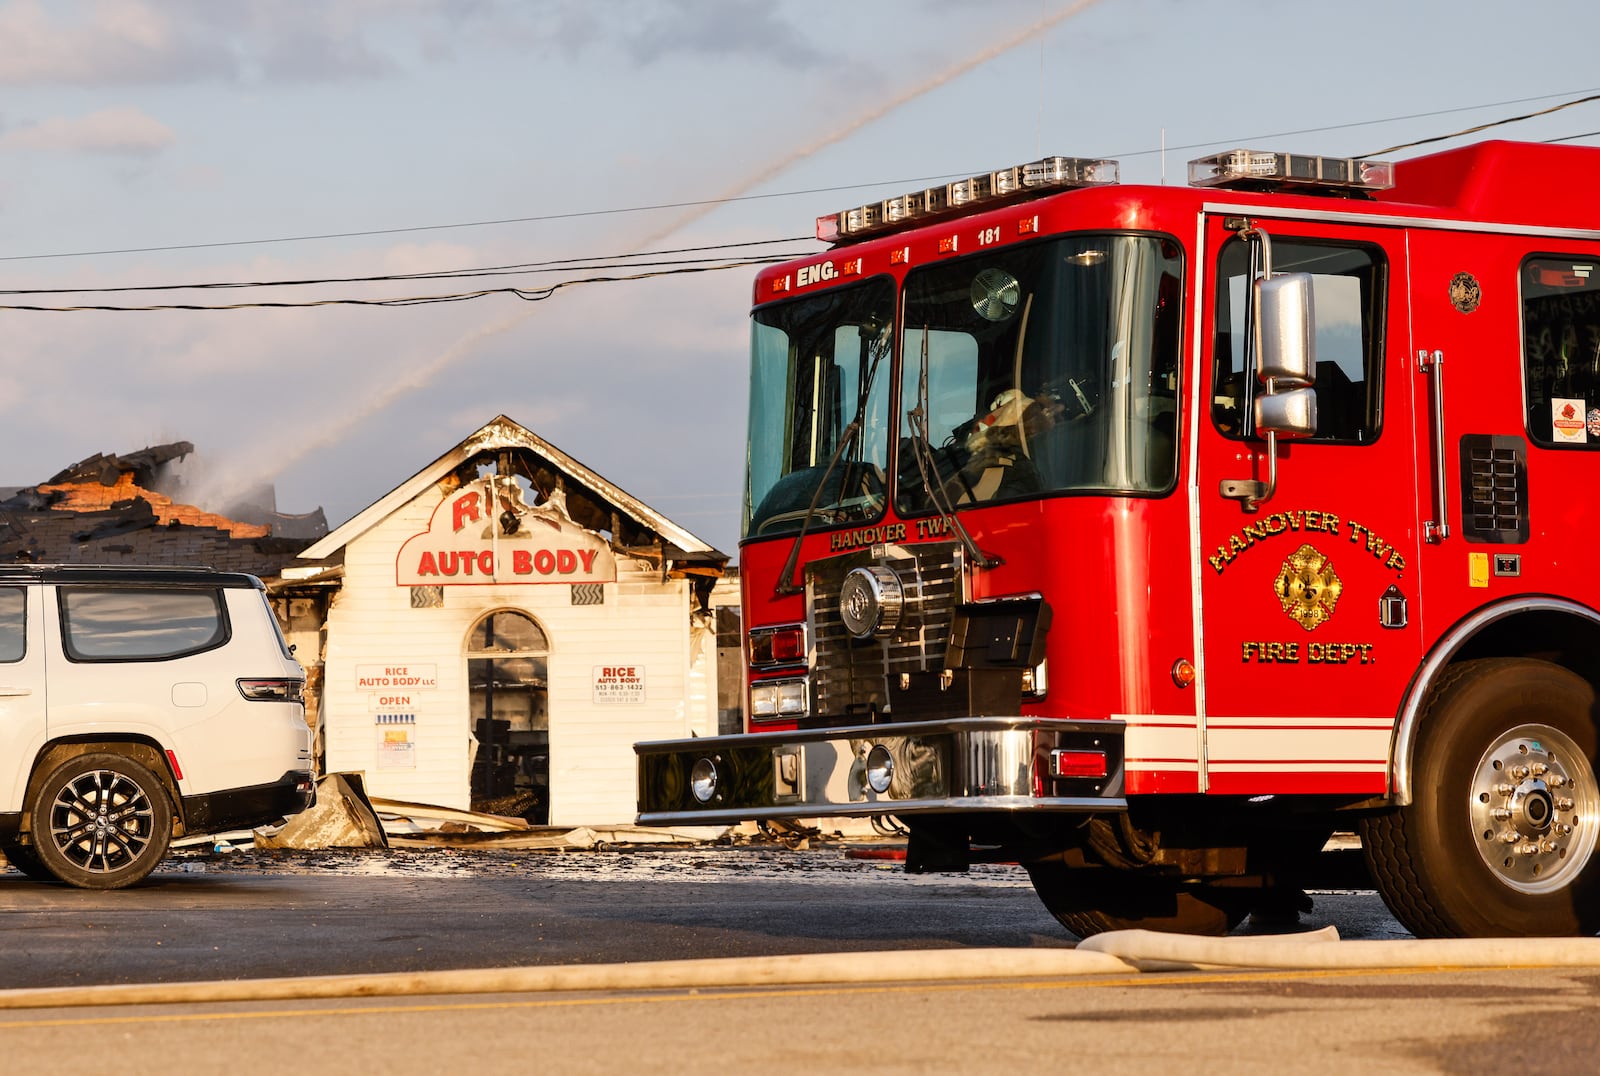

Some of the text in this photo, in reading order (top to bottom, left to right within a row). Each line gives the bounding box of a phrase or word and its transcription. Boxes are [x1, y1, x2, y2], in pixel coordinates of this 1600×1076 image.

[978, 226, 1000, 246] 181
[797, 261, 838, 287] ENG.
[831, 523, 906, 552] HANOVER
[1208, 510, 1340, 575] HANOVER
[417, 549, 599, 577] AUTO BODY
[1299, 609, 1319, 618] 1998
[1242, 641, 1376, 664] FIRE DEPT.
[385, 667, 408, 676] RICE
[602, 667, 636, 677] RICE
[359, 678, 390, 687] AUTO
[393, 677, 421, 686] BODY
[379, 696, 411, 706] OPEN
